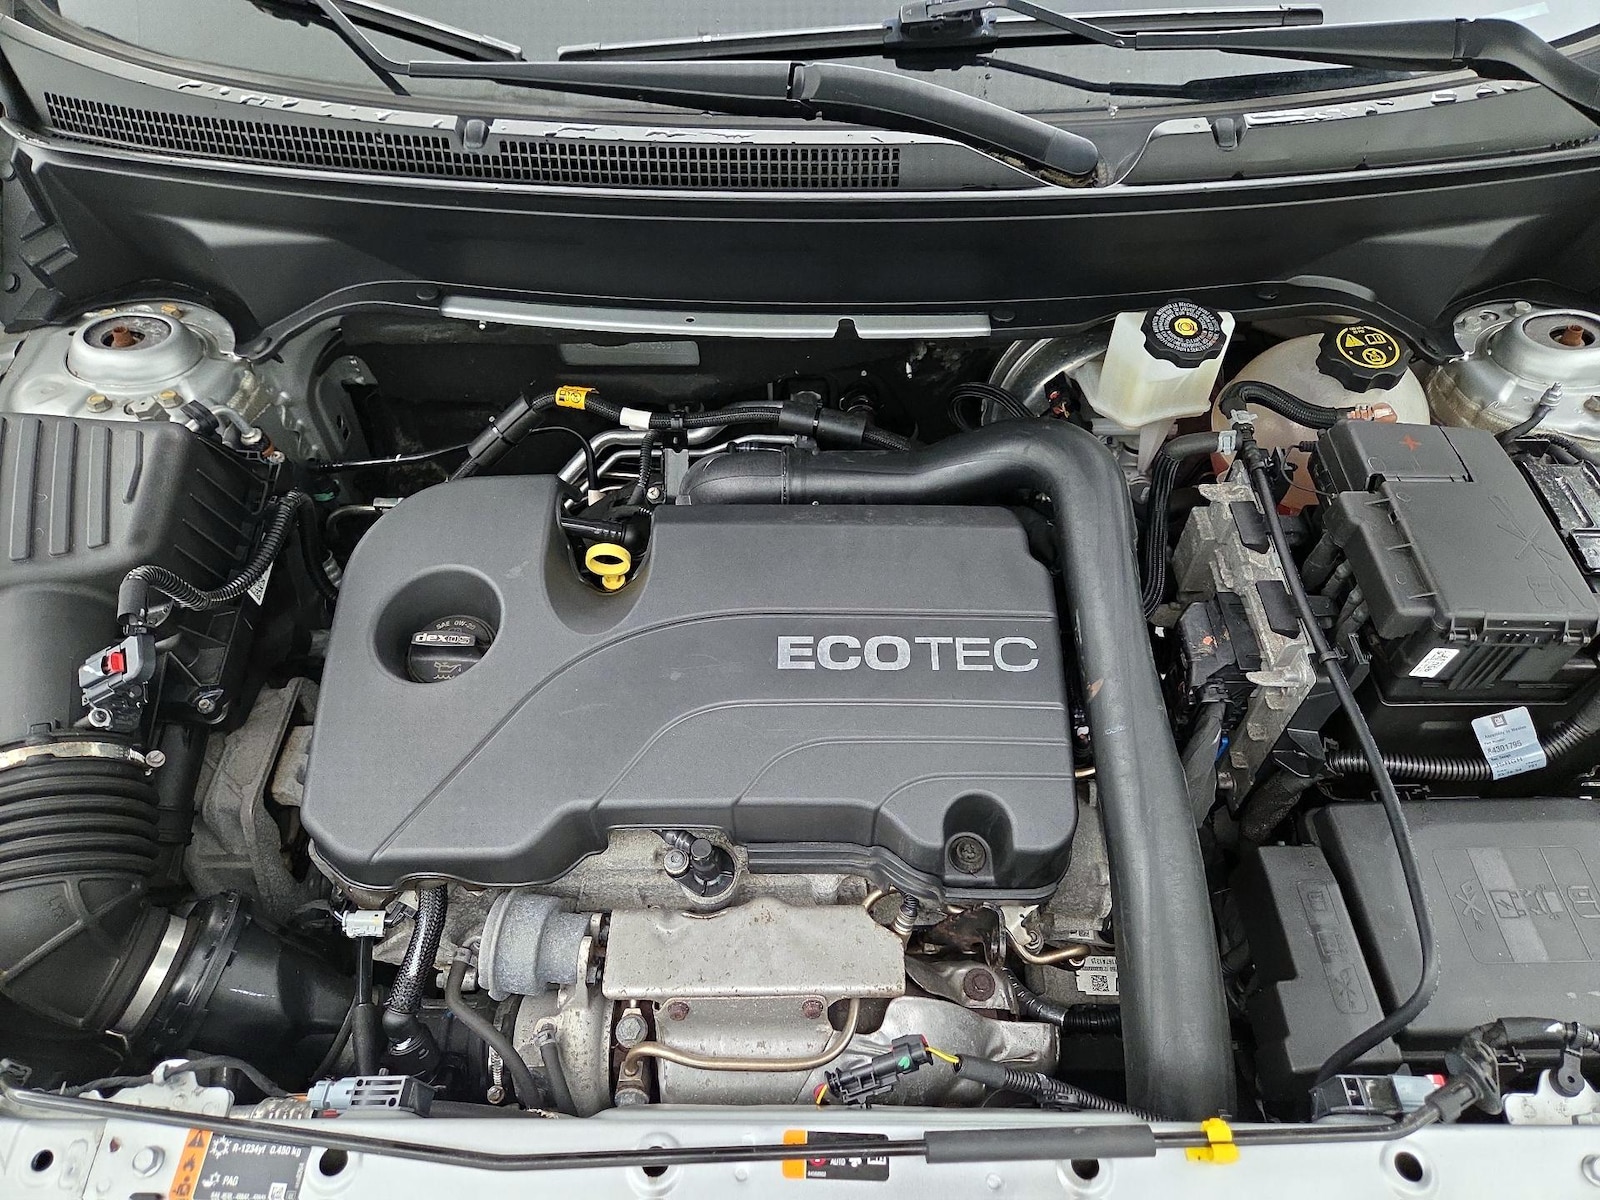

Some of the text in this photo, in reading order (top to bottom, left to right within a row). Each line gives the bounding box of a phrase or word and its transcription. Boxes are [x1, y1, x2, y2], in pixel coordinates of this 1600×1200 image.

[436, 621, 450, 630] SAE
[415, 633, 471, 644] dexos
[777, 635, 1039, 672] ECOTEC
[232, 1142, 267, 1155] R-1234yf
[291, 1146, 302, 1157] kg
[223, 1176, 238, 1186] PAG
